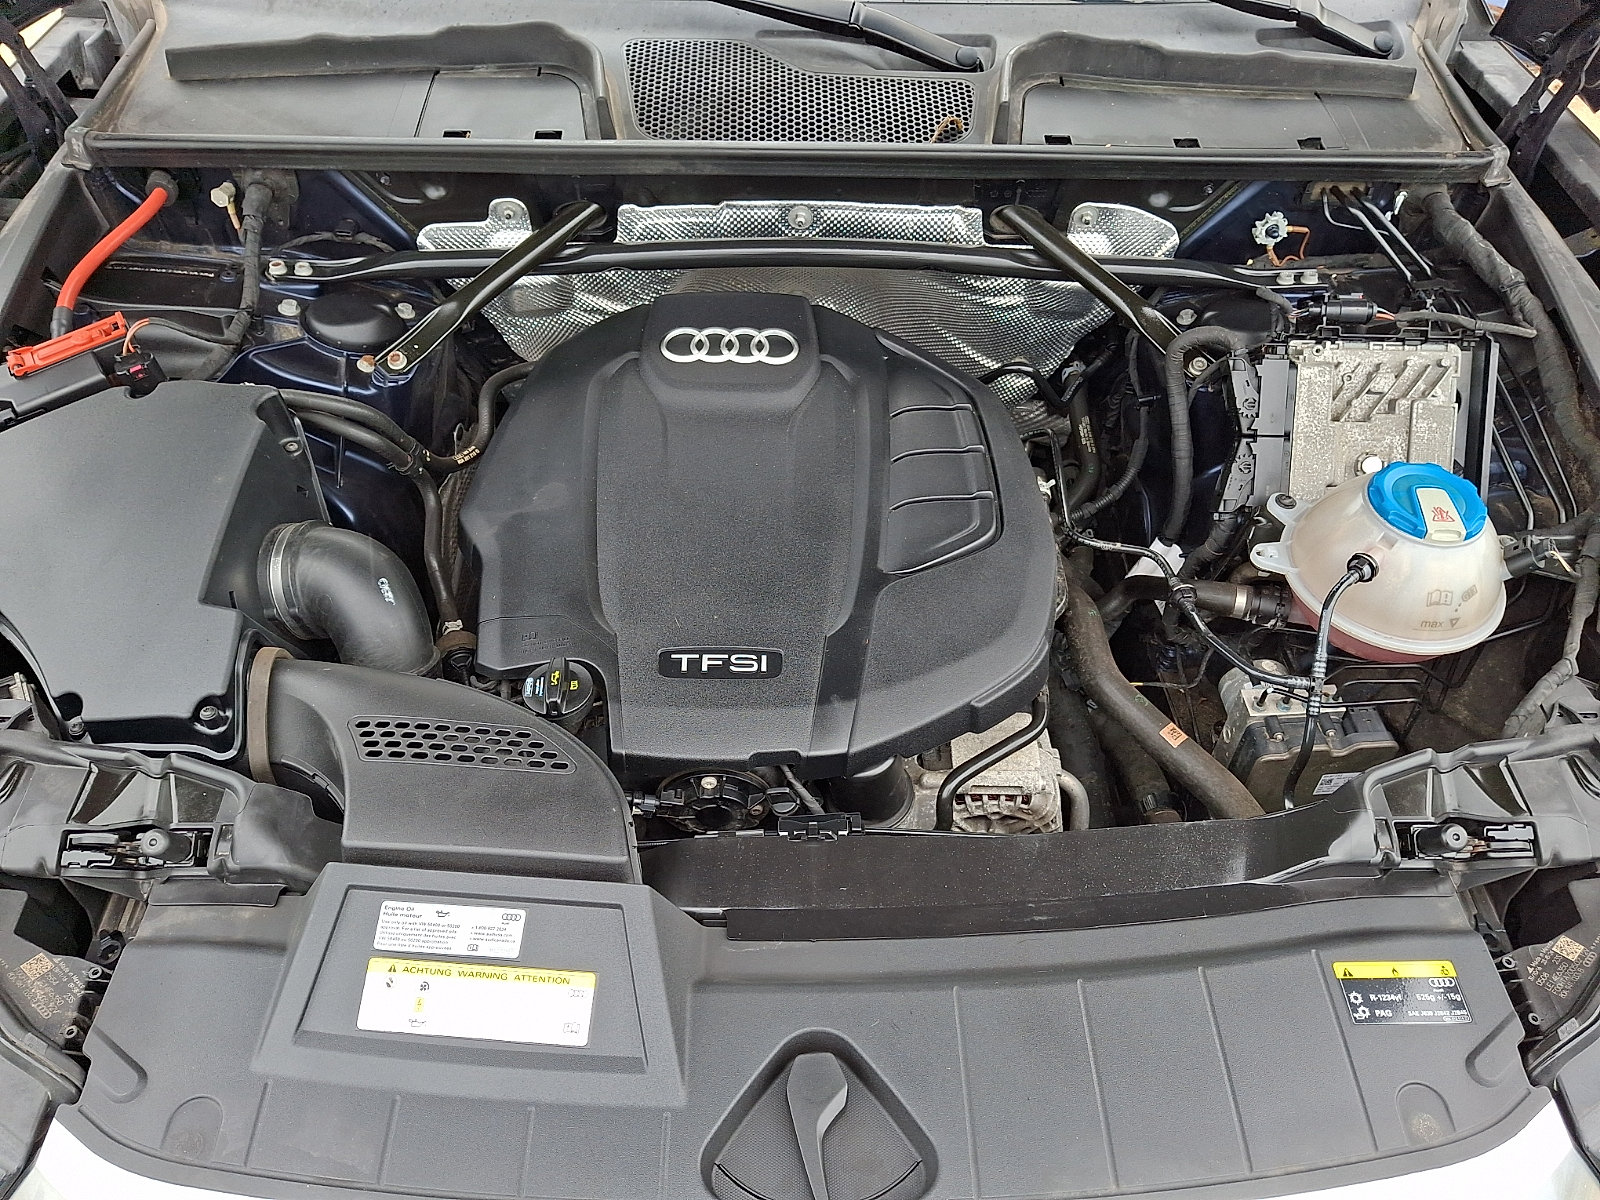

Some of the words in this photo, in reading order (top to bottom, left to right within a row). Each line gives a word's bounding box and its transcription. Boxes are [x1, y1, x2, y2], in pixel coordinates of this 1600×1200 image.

[1420, 620, 1444, 628] max
[671, 654, 767, 672] TFSI
[402, 965, 452, 977] ACHTUNG
[458, 970, 508, 981] WARNING
[514, 974, 571, 985] ATTENTION
[1375, 1009, 1392, 1018] PAG
